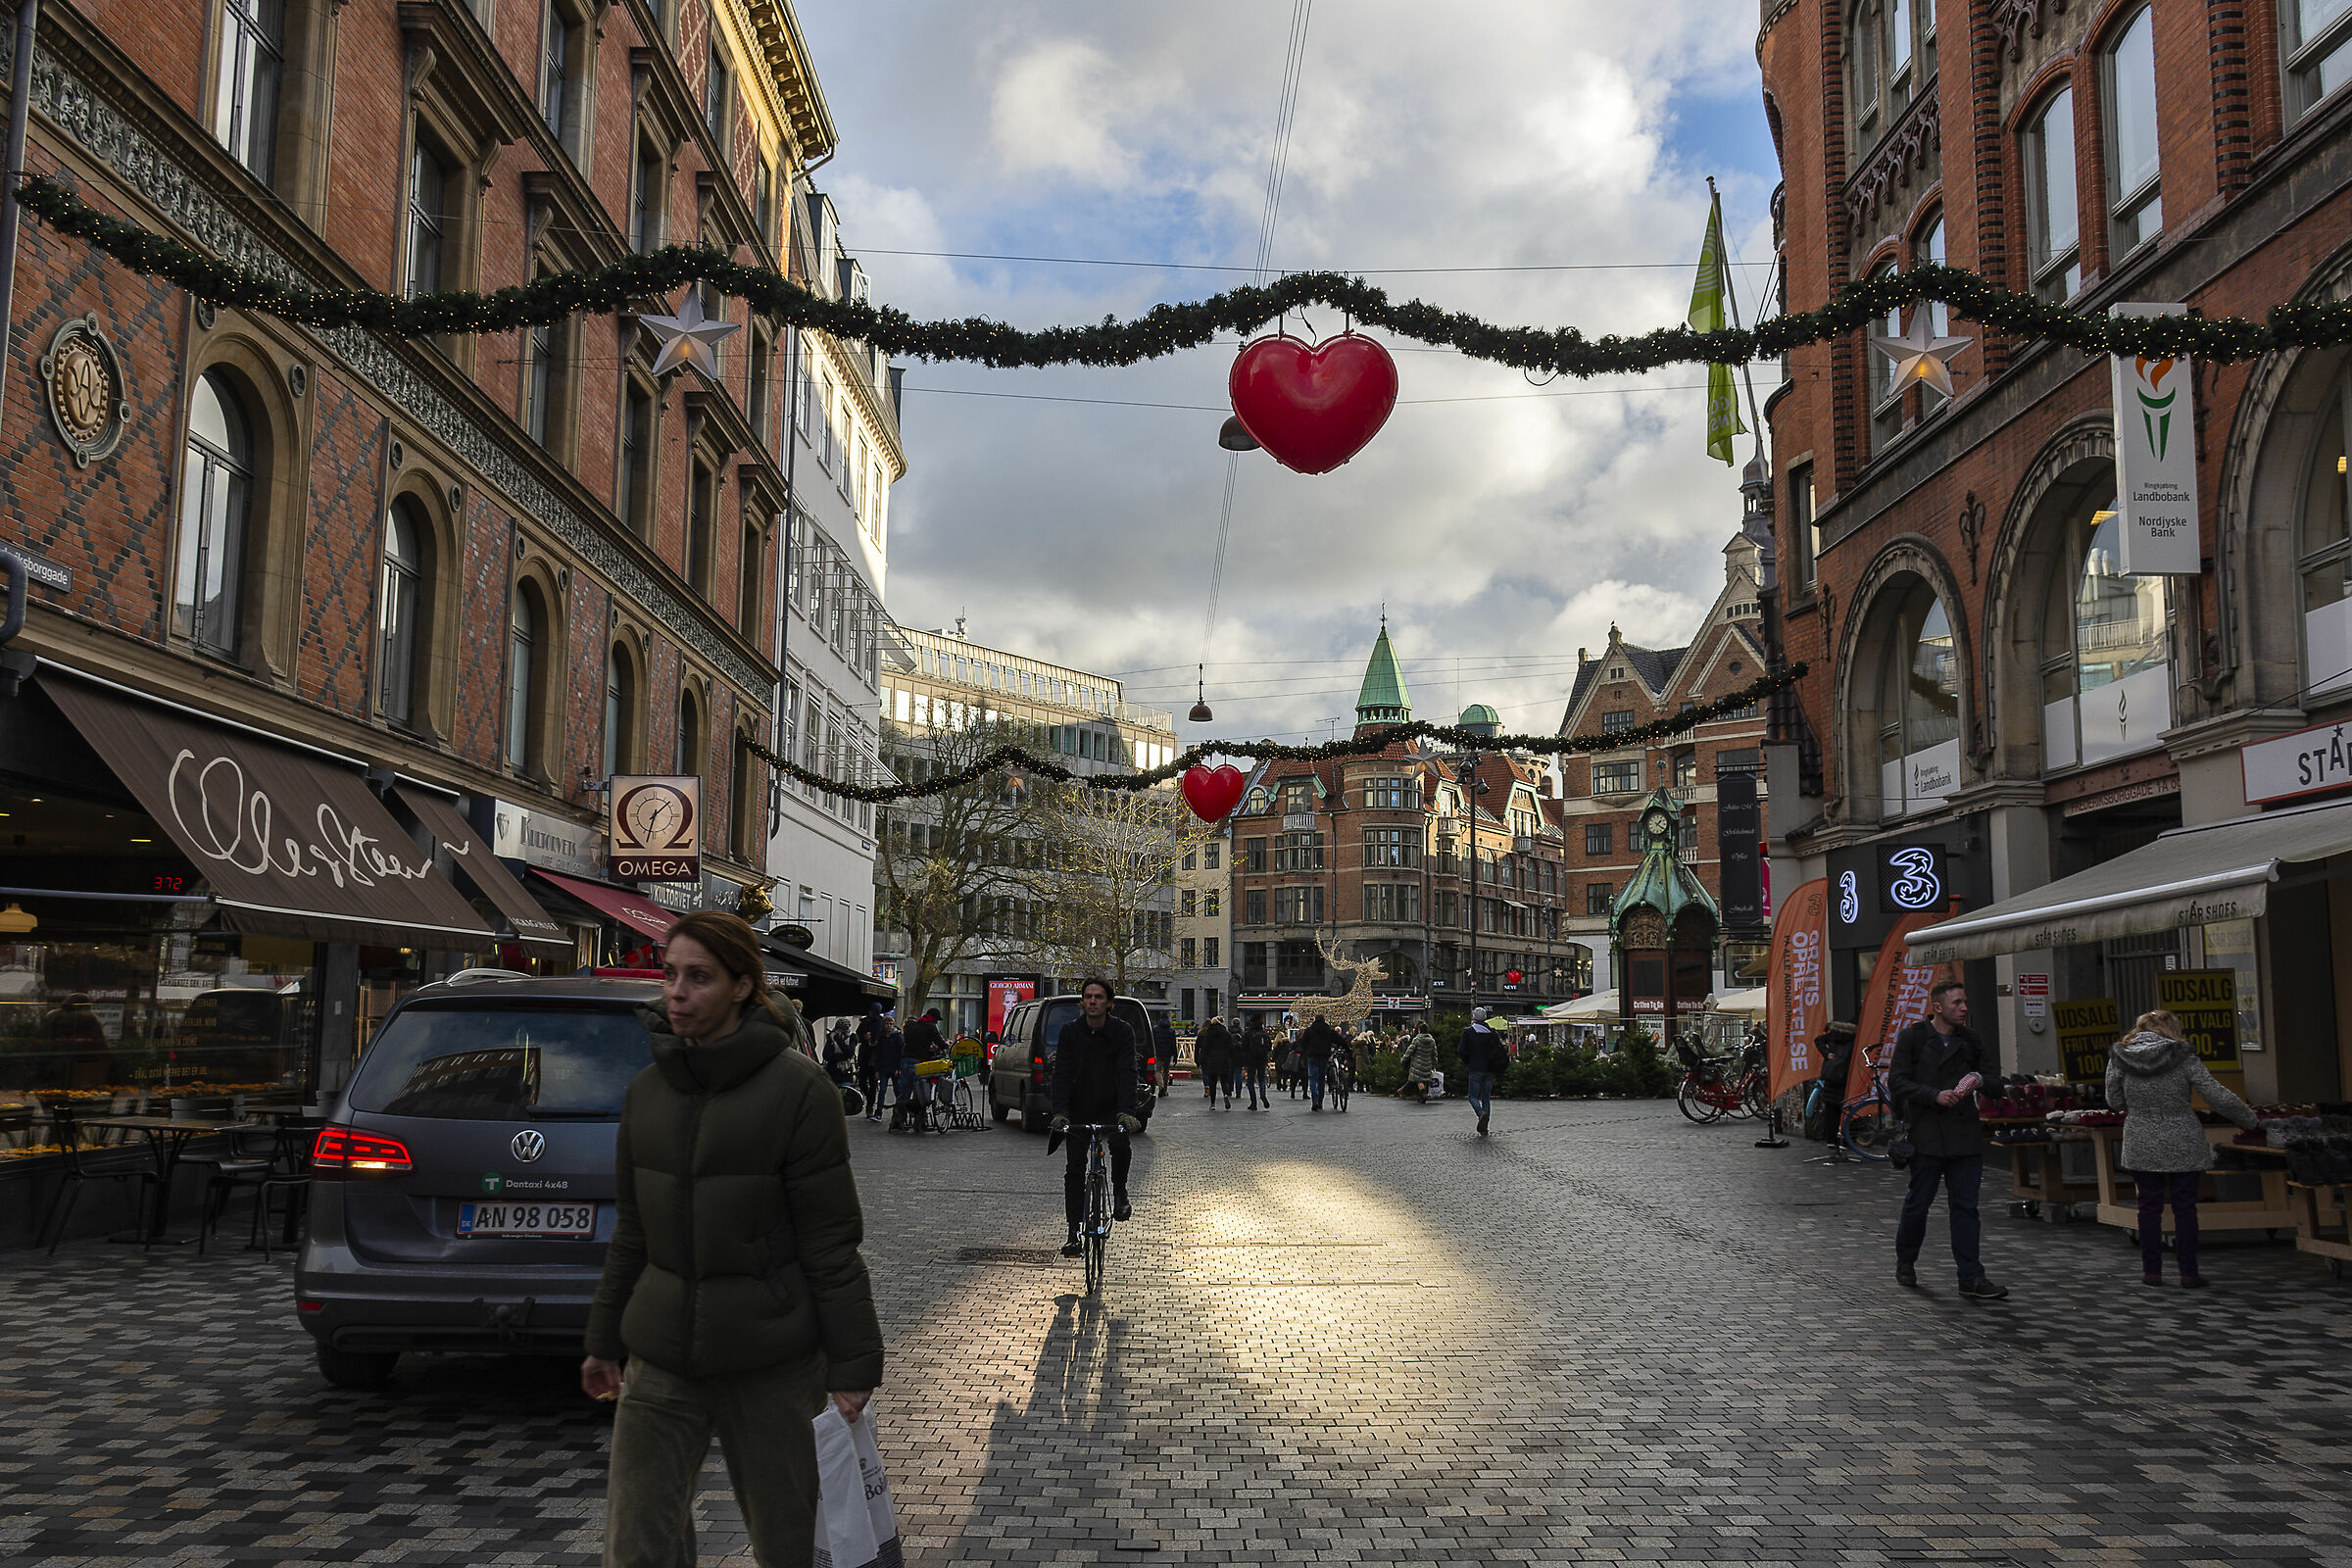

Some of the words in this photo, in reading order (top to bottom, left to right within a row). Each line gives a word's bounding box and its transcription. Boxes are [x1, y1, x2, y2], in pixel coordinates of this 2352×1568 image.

[2132, 491, 2190, 503] Landbobank
[2138, 515, 2187, 528] Nordjyske
[2151, 527, 2176, 538] Bank
[1921, 772, 1951, 792] Landbobank
[618, 860, 692, 876] OMEGA
[155, 877, 182, 890] 372
[1889, 848, 1939, 908] 3
[1839, 870, 1858, 923] 3
[2206, 902, 2236, 920] SHOES
[1805, 930, 1820, 1006] GRATIS
[2161, 978, 2232, 1003] UDSALG
[1789, 931, 1808, 1071] OPRETTELSE
[2055, 1004, 2118, 1028] UDSALG
[2198, 1011, 2231, 1028] VALG
[2063, 1035, 2089, 1053] FRIT
[506, 1179, 543, 1189] Dantaxi
[545, 1180, 568, 1189] 4x48
[475, 1206, 507, 1228] AN
[513, 1206, 541, 1228] 98
[546, 1207, 590, 1229] 058
